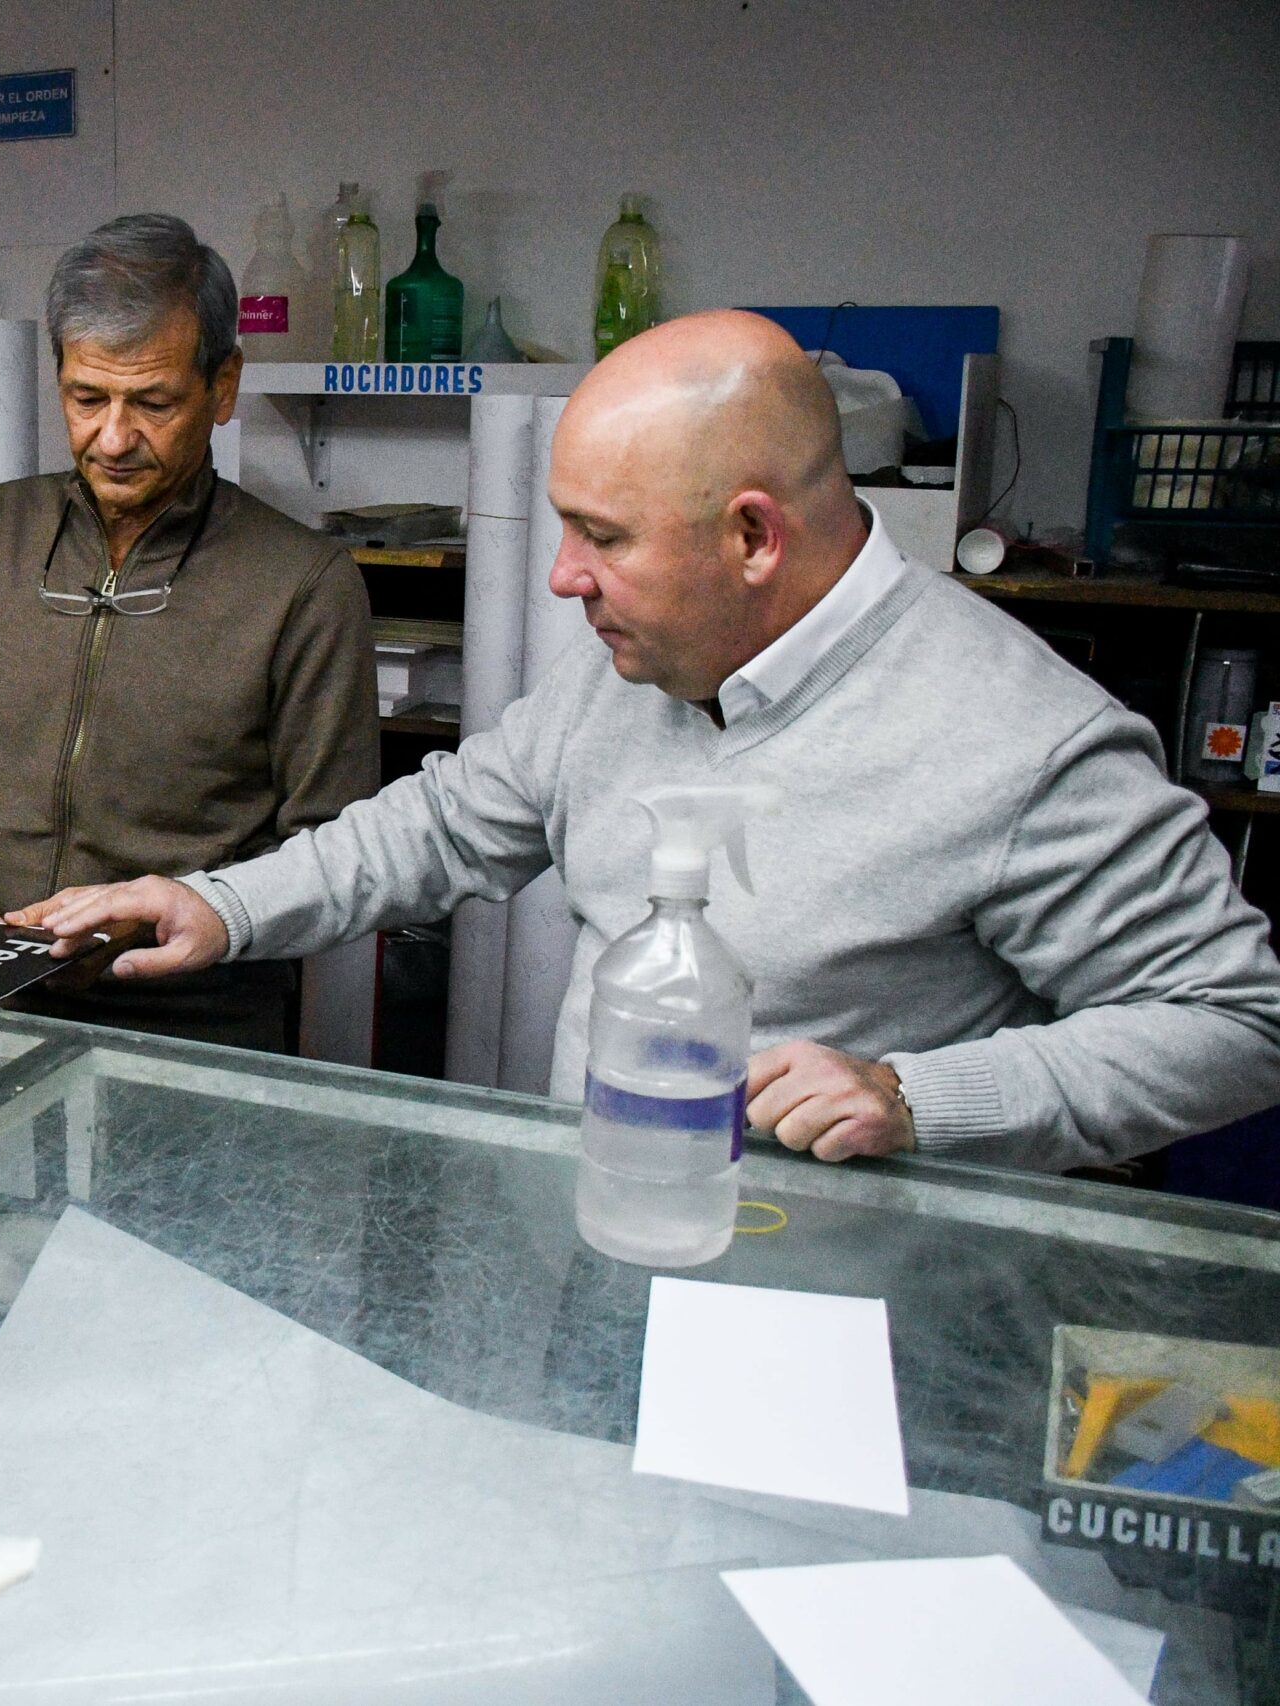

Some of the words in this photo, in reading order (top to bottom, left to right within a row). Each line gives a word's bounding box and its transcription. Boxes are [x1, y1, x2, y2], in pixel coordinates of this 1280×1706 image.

[8, 92, 23, 104] EL
[26, 88, 68, 102] ORDEN
[324, 364, 483, 394] ROCIADORES
